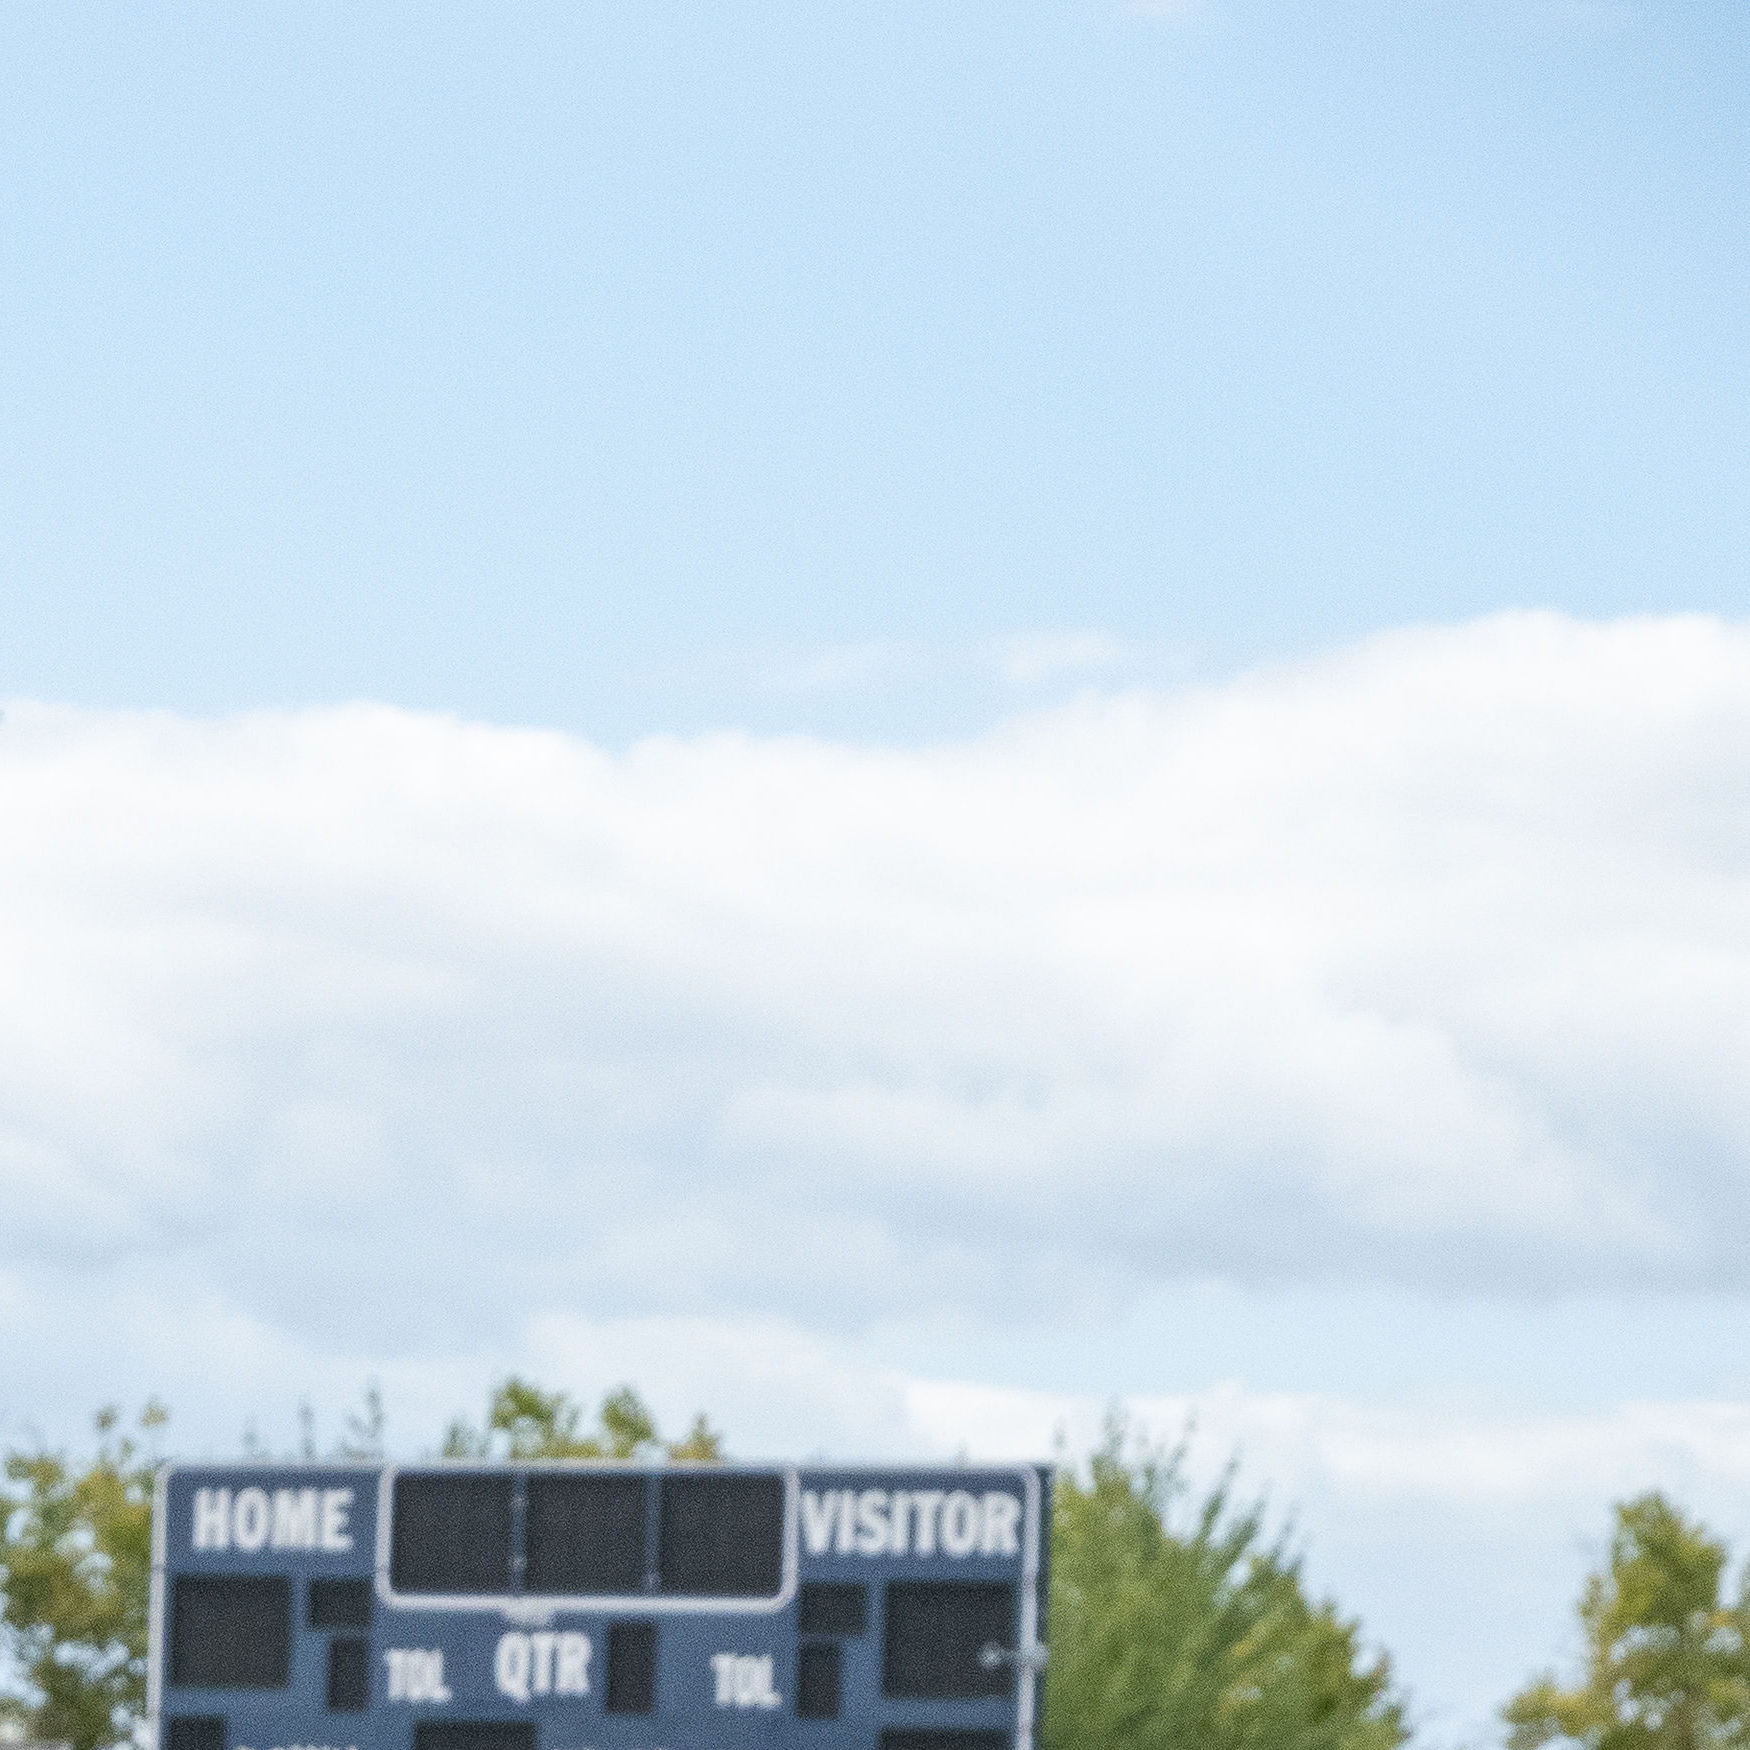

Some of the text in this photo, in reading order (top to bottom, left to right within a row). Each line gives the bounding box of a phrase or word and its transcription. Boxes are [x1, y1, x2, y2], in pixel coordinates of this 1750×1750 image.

[193, 1488, 353, 1552] HOME
[799, 1490, 1021, 1556] VISITOR
[385, 1649, 451, 1704] TOL
[494, 1631, 592, 1701] QTR
[712, 1653, 780, 1708] TOL
